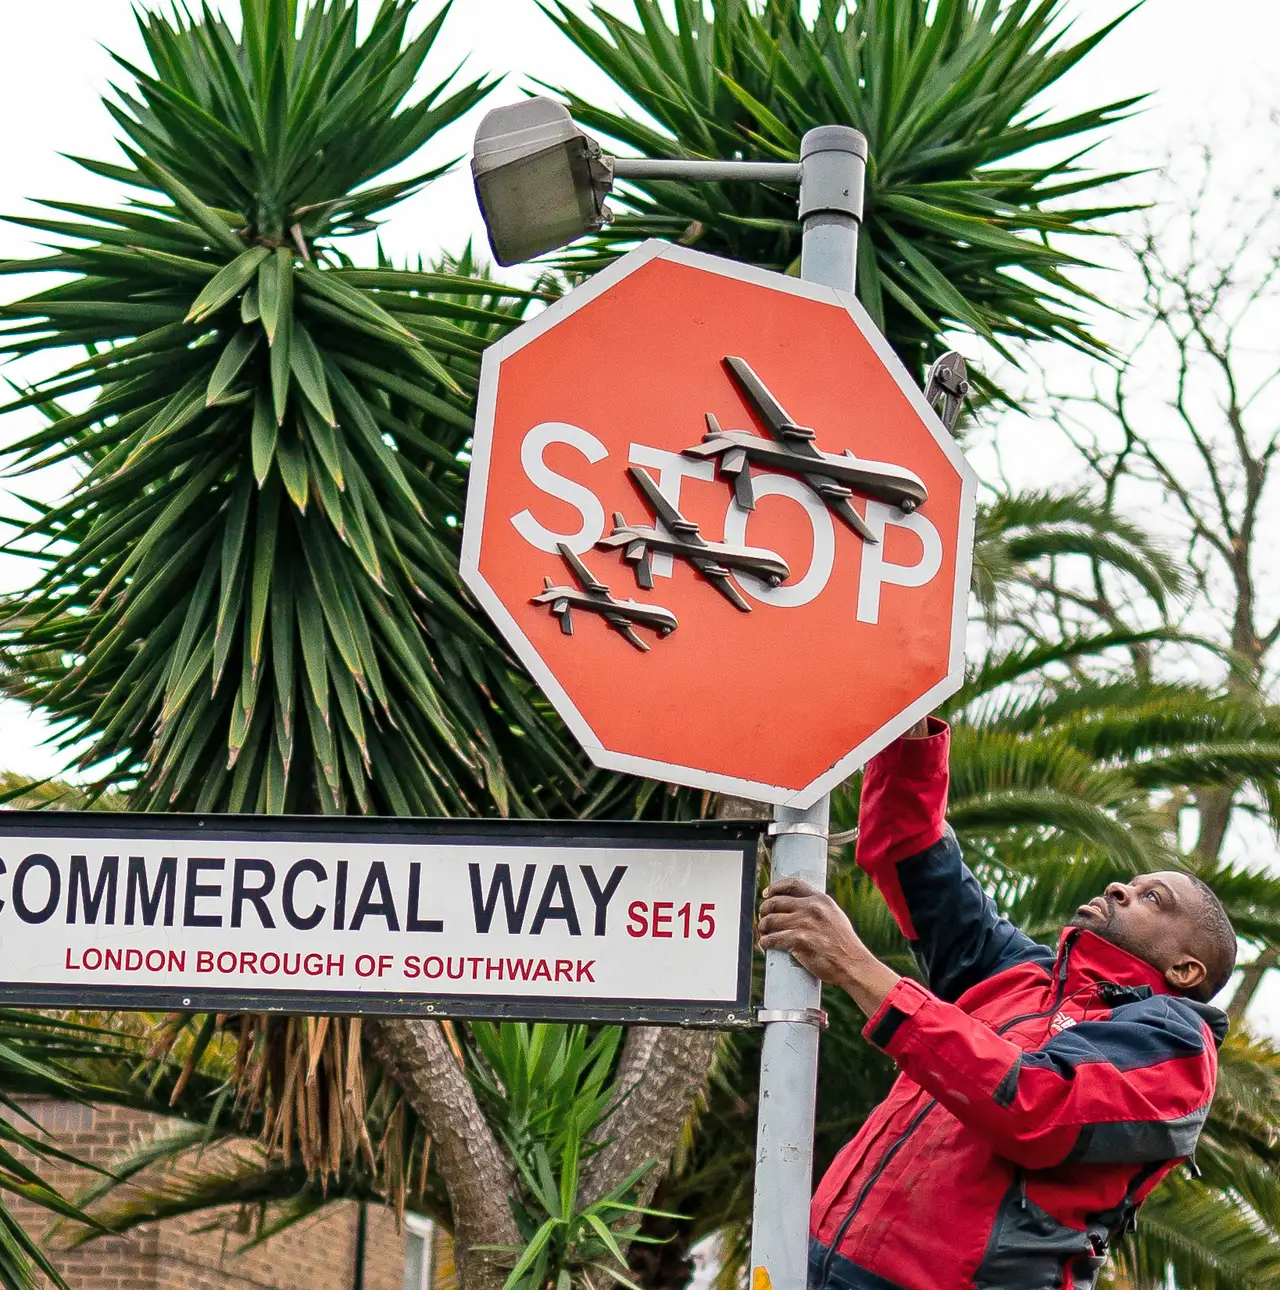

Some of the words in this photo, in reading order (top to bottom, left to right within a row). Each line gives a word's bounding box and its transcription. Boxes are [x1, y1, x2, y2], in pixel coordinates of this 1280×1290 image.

[469, 863, 628, 936] WAY
[627, 901, 715, 939] SE15
[66, 948, 185, 972] LONDON
[197, 951, 344, 976] BOROUGH
[355, 954, 392, 976] OF
[404, 956, 594, 982] SOUTHWARK
